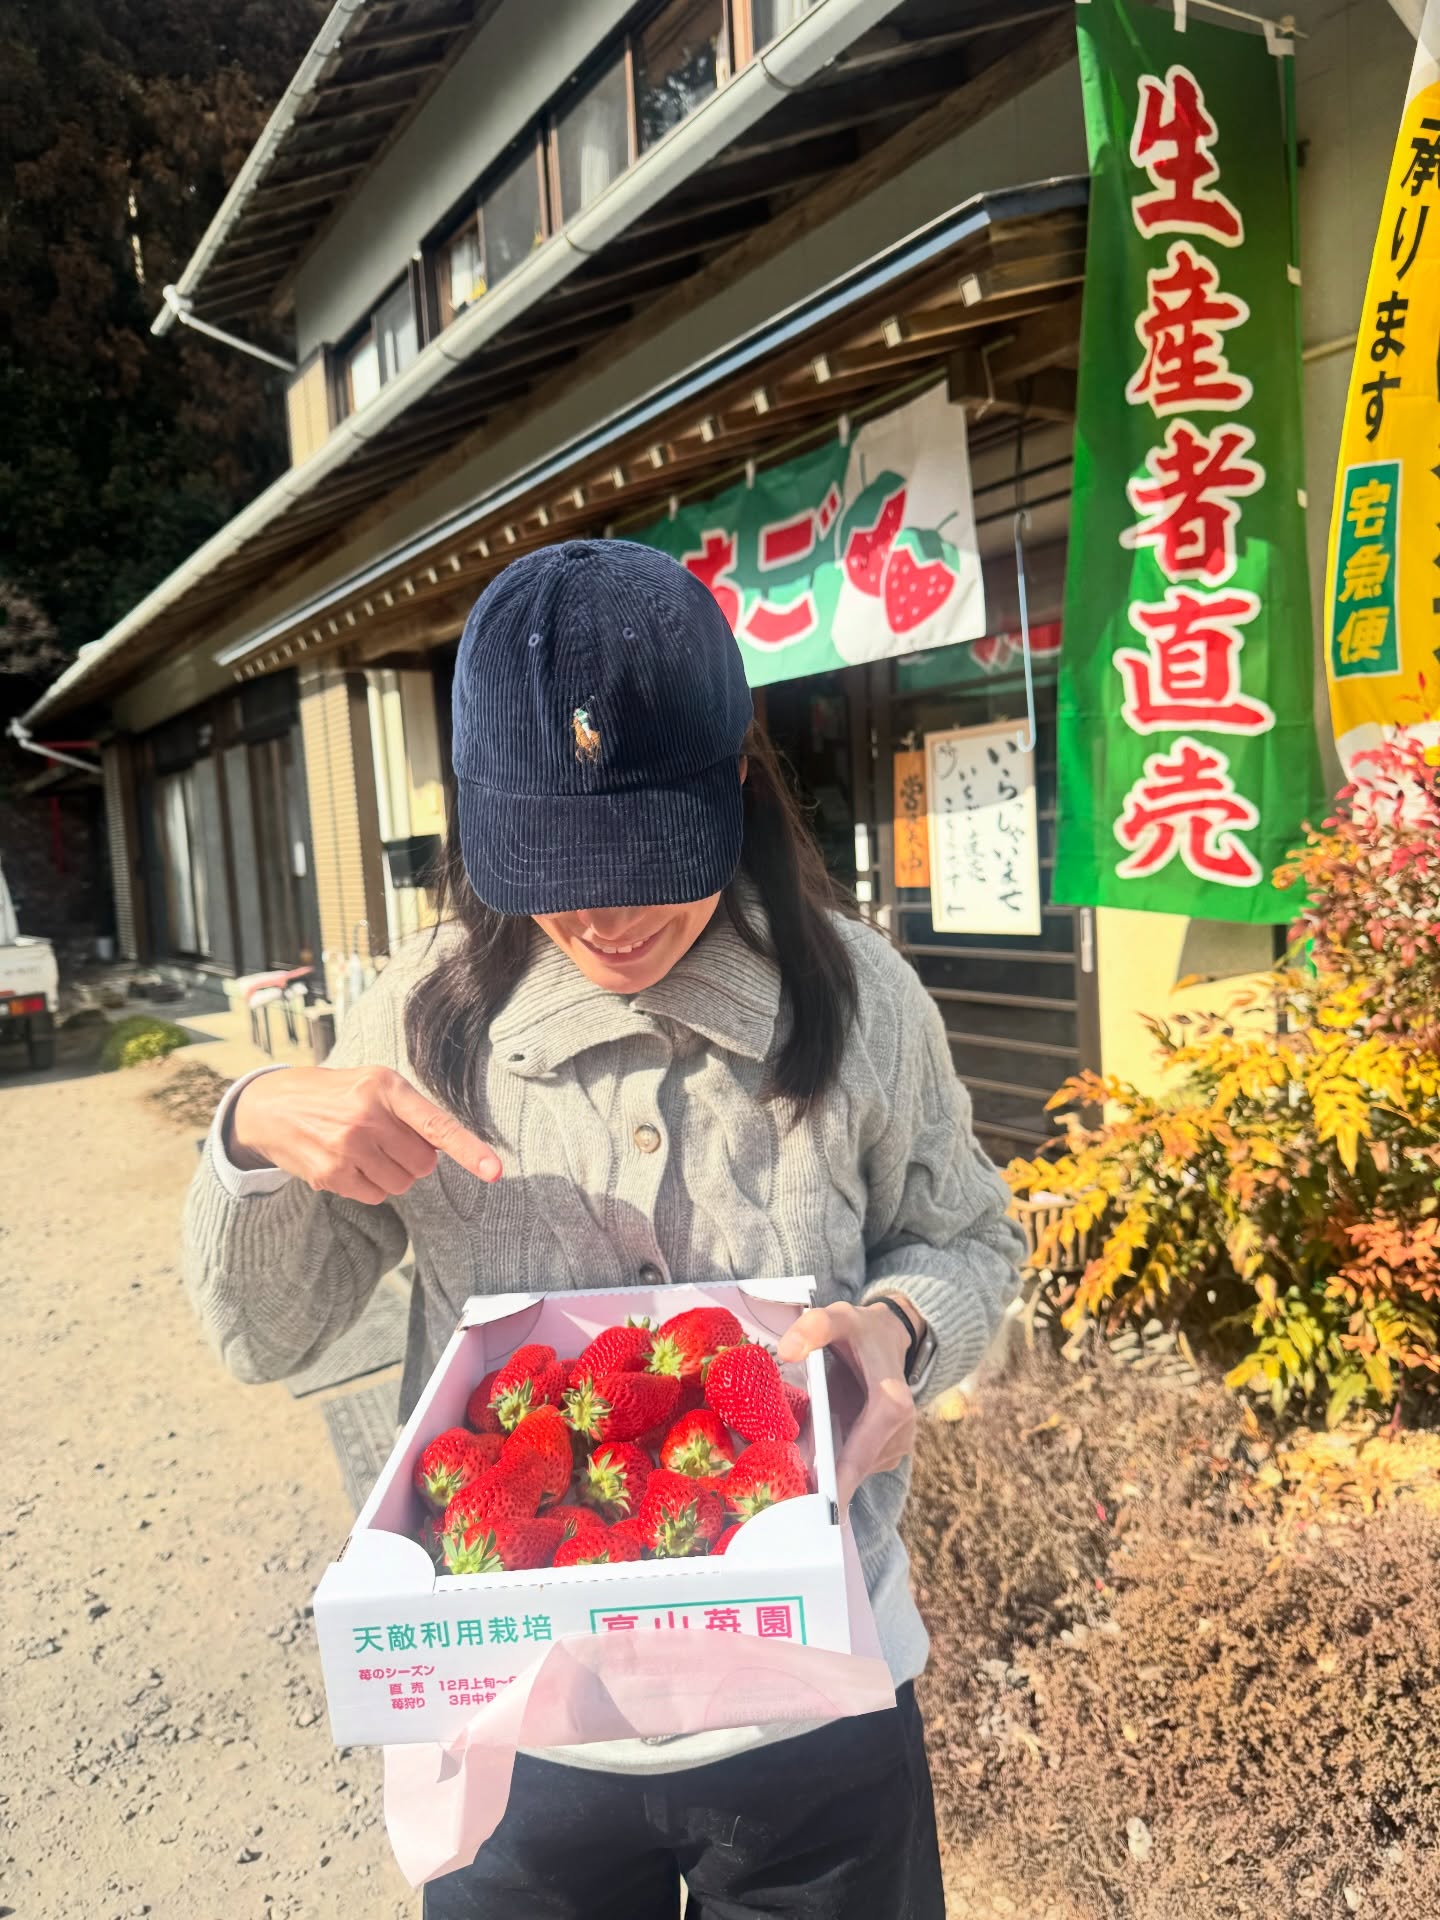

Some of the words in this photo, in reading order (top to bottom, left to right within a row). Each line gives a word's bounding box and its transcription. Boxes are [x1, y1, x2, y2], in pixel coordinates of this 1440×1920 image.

[1361, 117, 1440, 442] 承ります
[1114, 66, 1274, 884] 生産者直売
[1338, 479, 1392, 665] 宅急便
[352, 1614, 552, 1653] 天敵利用栽培
[358, 1665, 436, 1681] 苺のシーズン
[391, 1696, 426, 1710] 苺狩り
